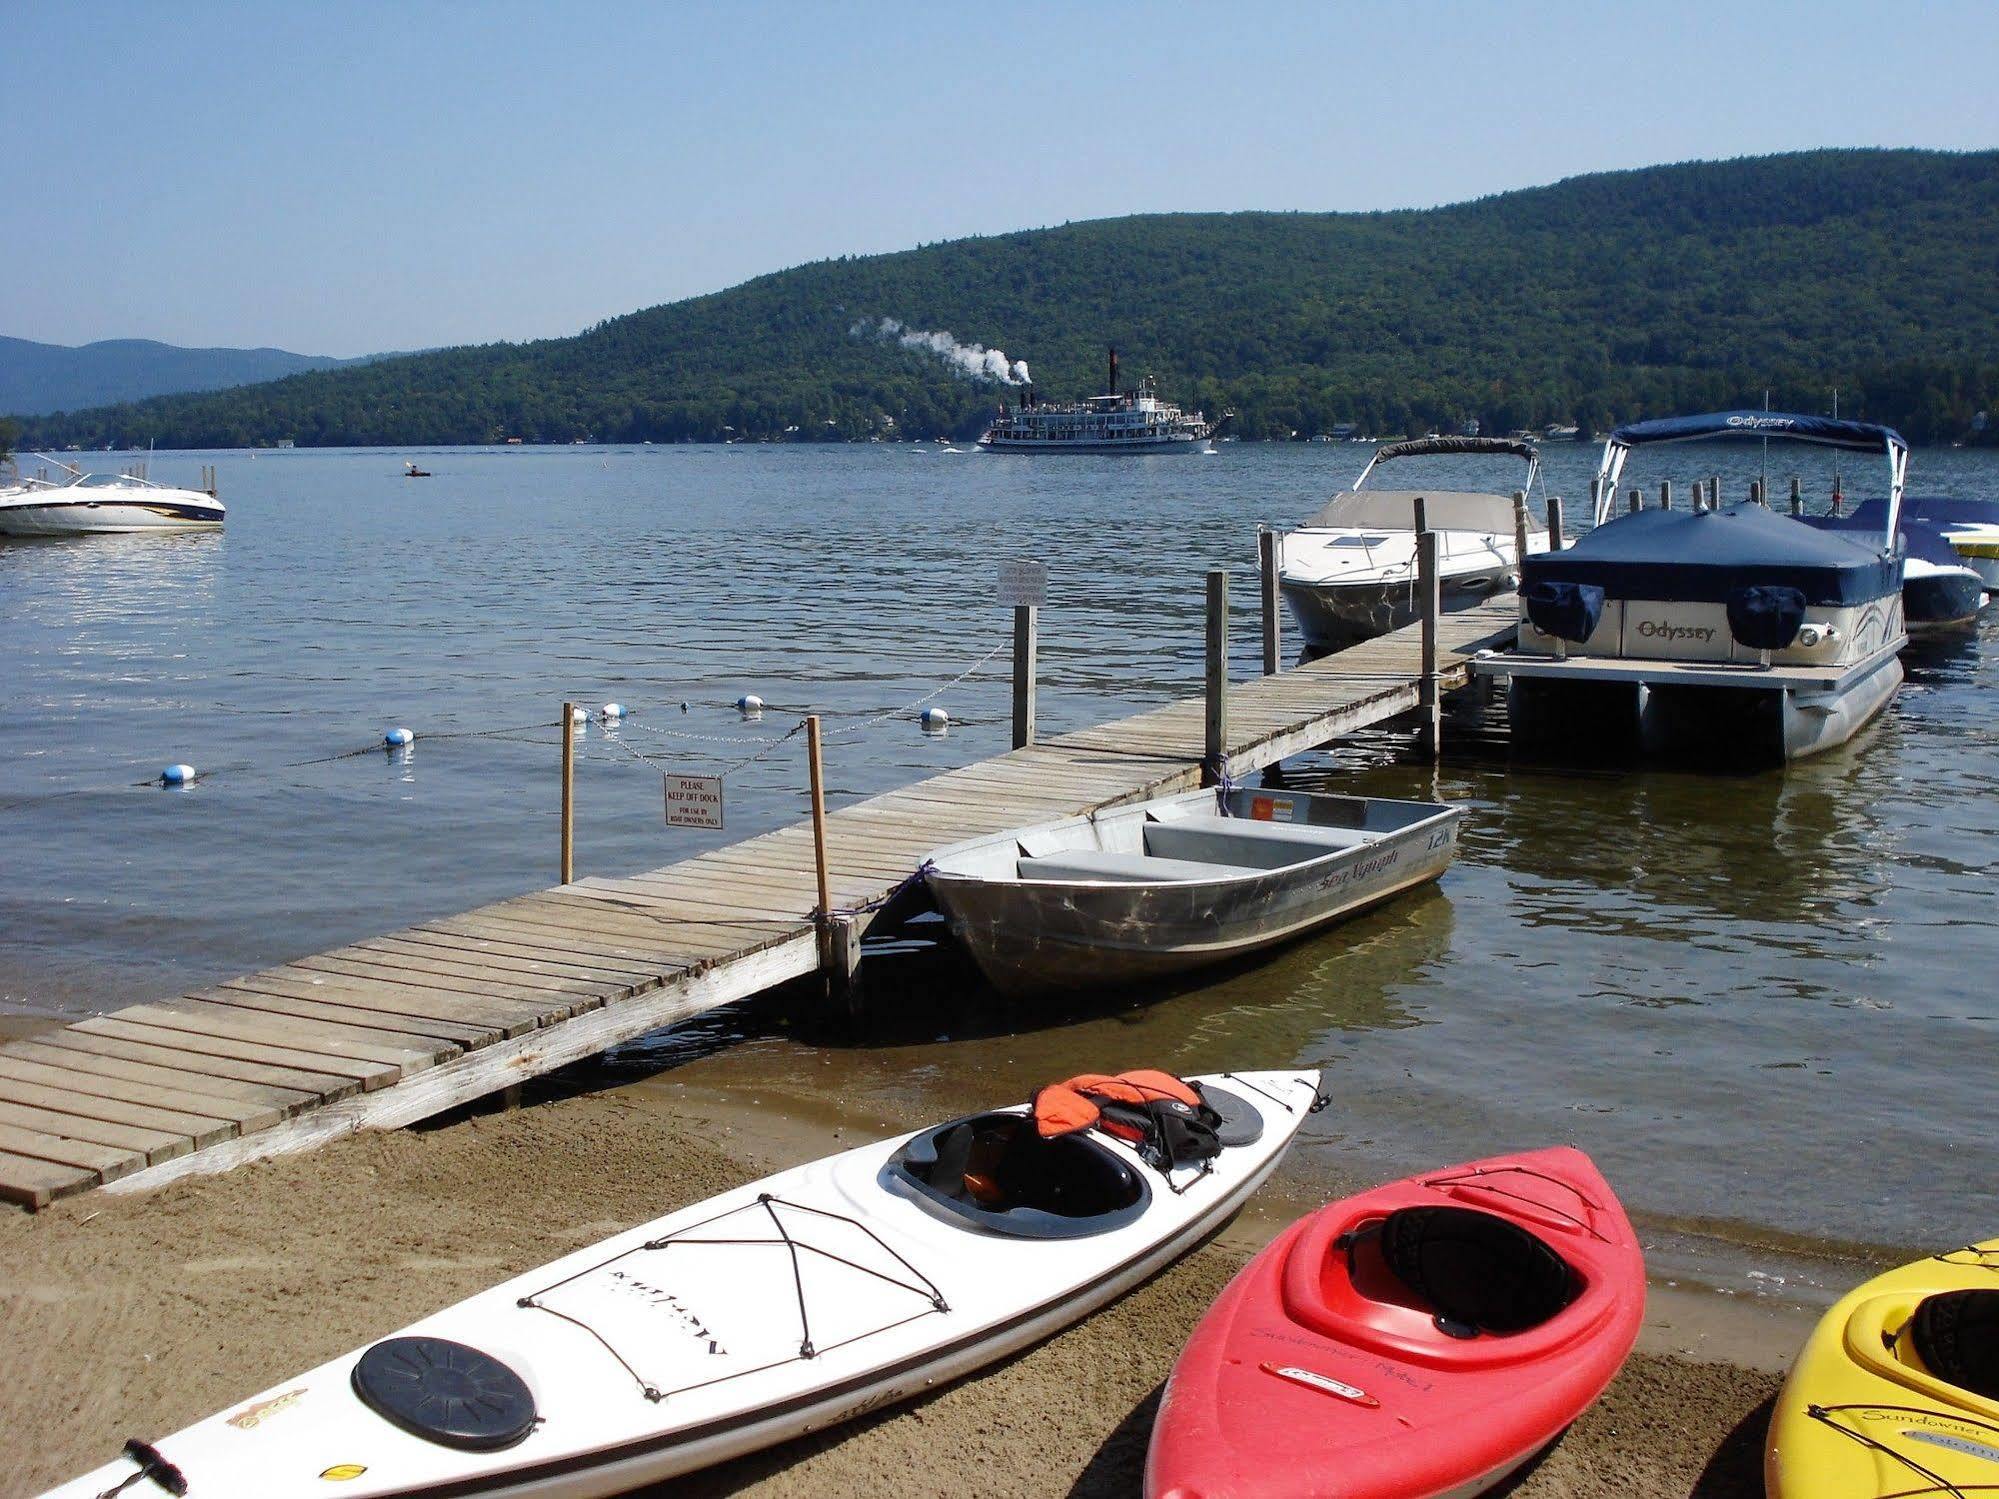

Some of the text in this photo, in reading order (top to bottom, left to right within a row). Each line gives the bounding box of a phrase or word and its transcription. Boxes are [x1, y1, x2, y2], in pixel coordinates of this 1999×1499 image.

[1726, 415, 1795, 429] Odyssey
[1636, 620, 1717, 643] Odyssey
[681, 781, 704, 790] PLEASE
[668, 792, 719, 803] KEEP OFF DOCK
[1318, 850, 1399, 891] Sea Nymph
[1861, 1409, 1986, 1436] Sundowner
